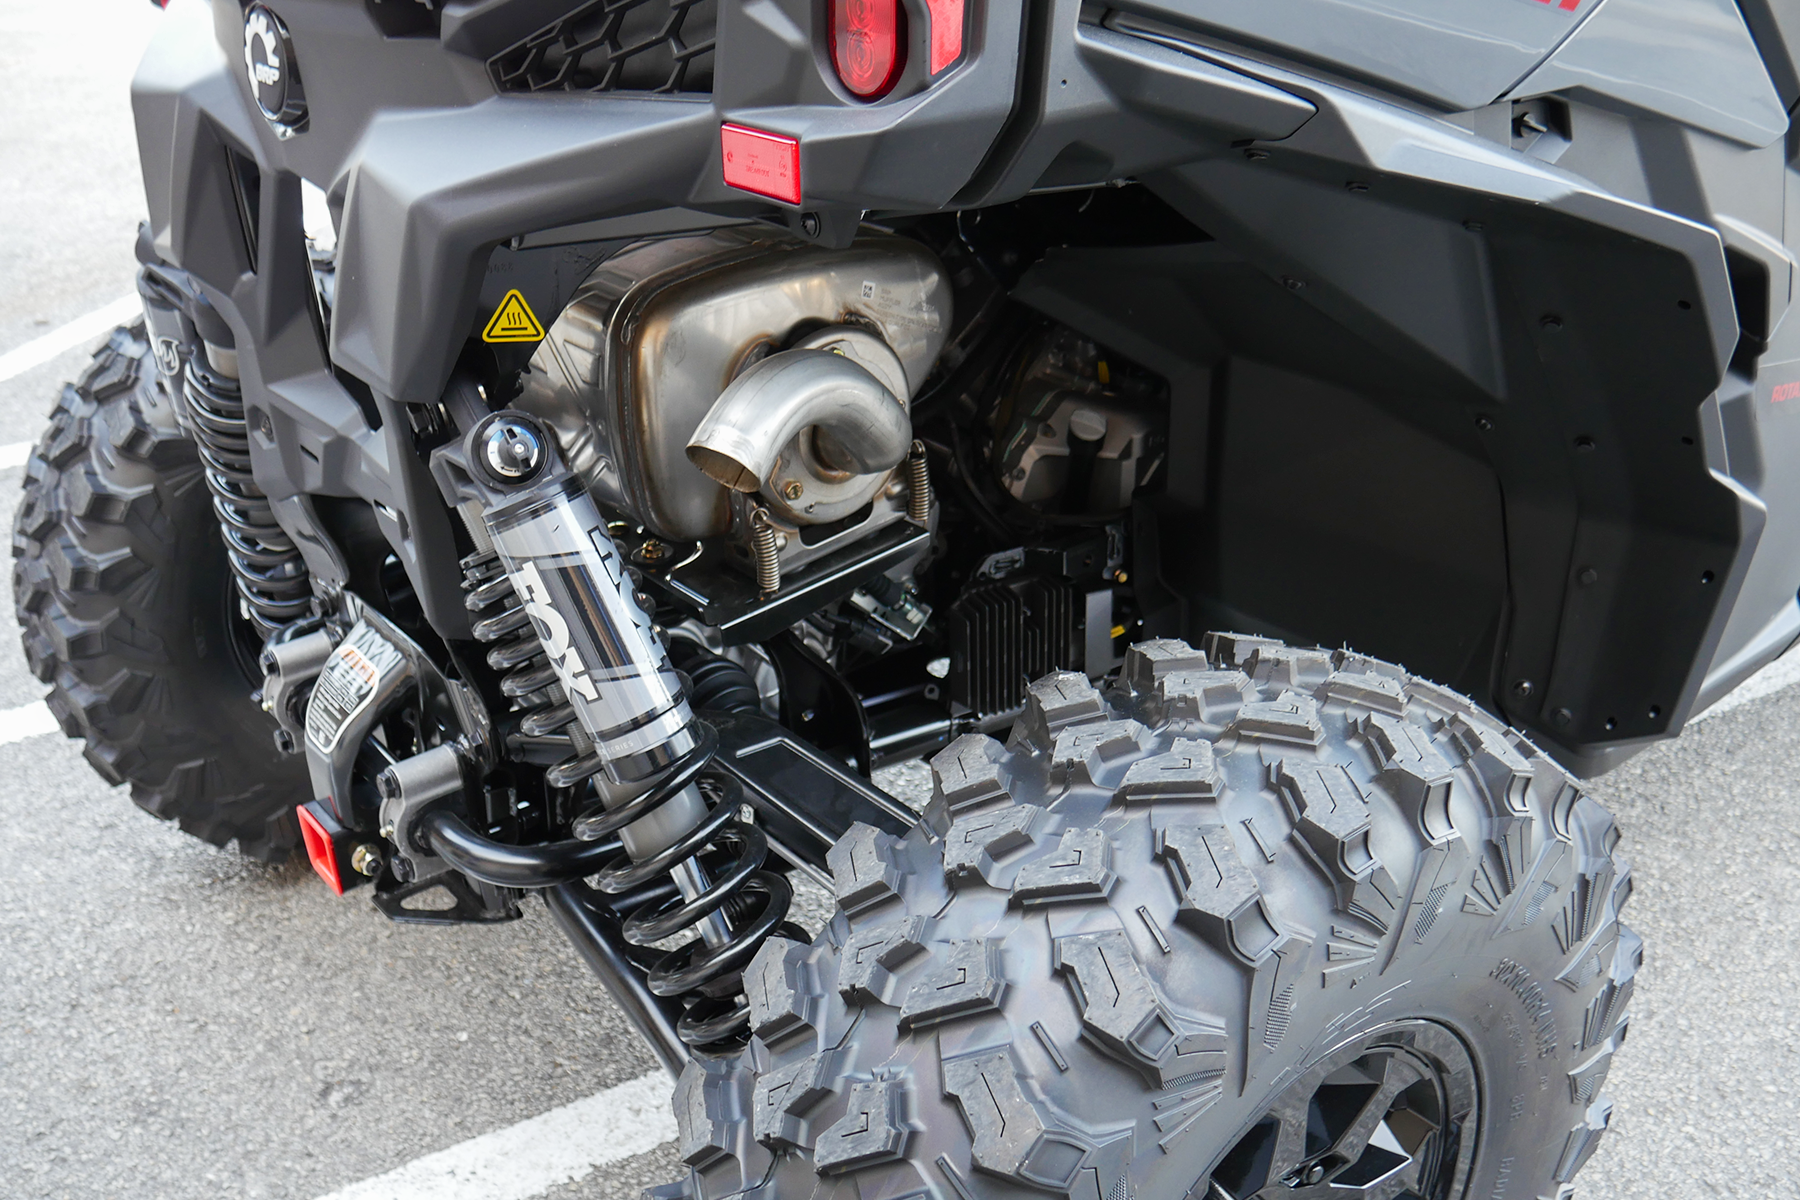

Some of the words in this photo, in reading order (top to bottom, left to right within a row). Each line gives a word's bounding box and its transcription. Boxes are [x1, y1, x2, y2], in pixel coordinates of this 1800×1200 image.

[255, 63, 280, 86] BRP
[508, 561, 600, 703] FOX
[607, 740, 634, 754] SERIES
